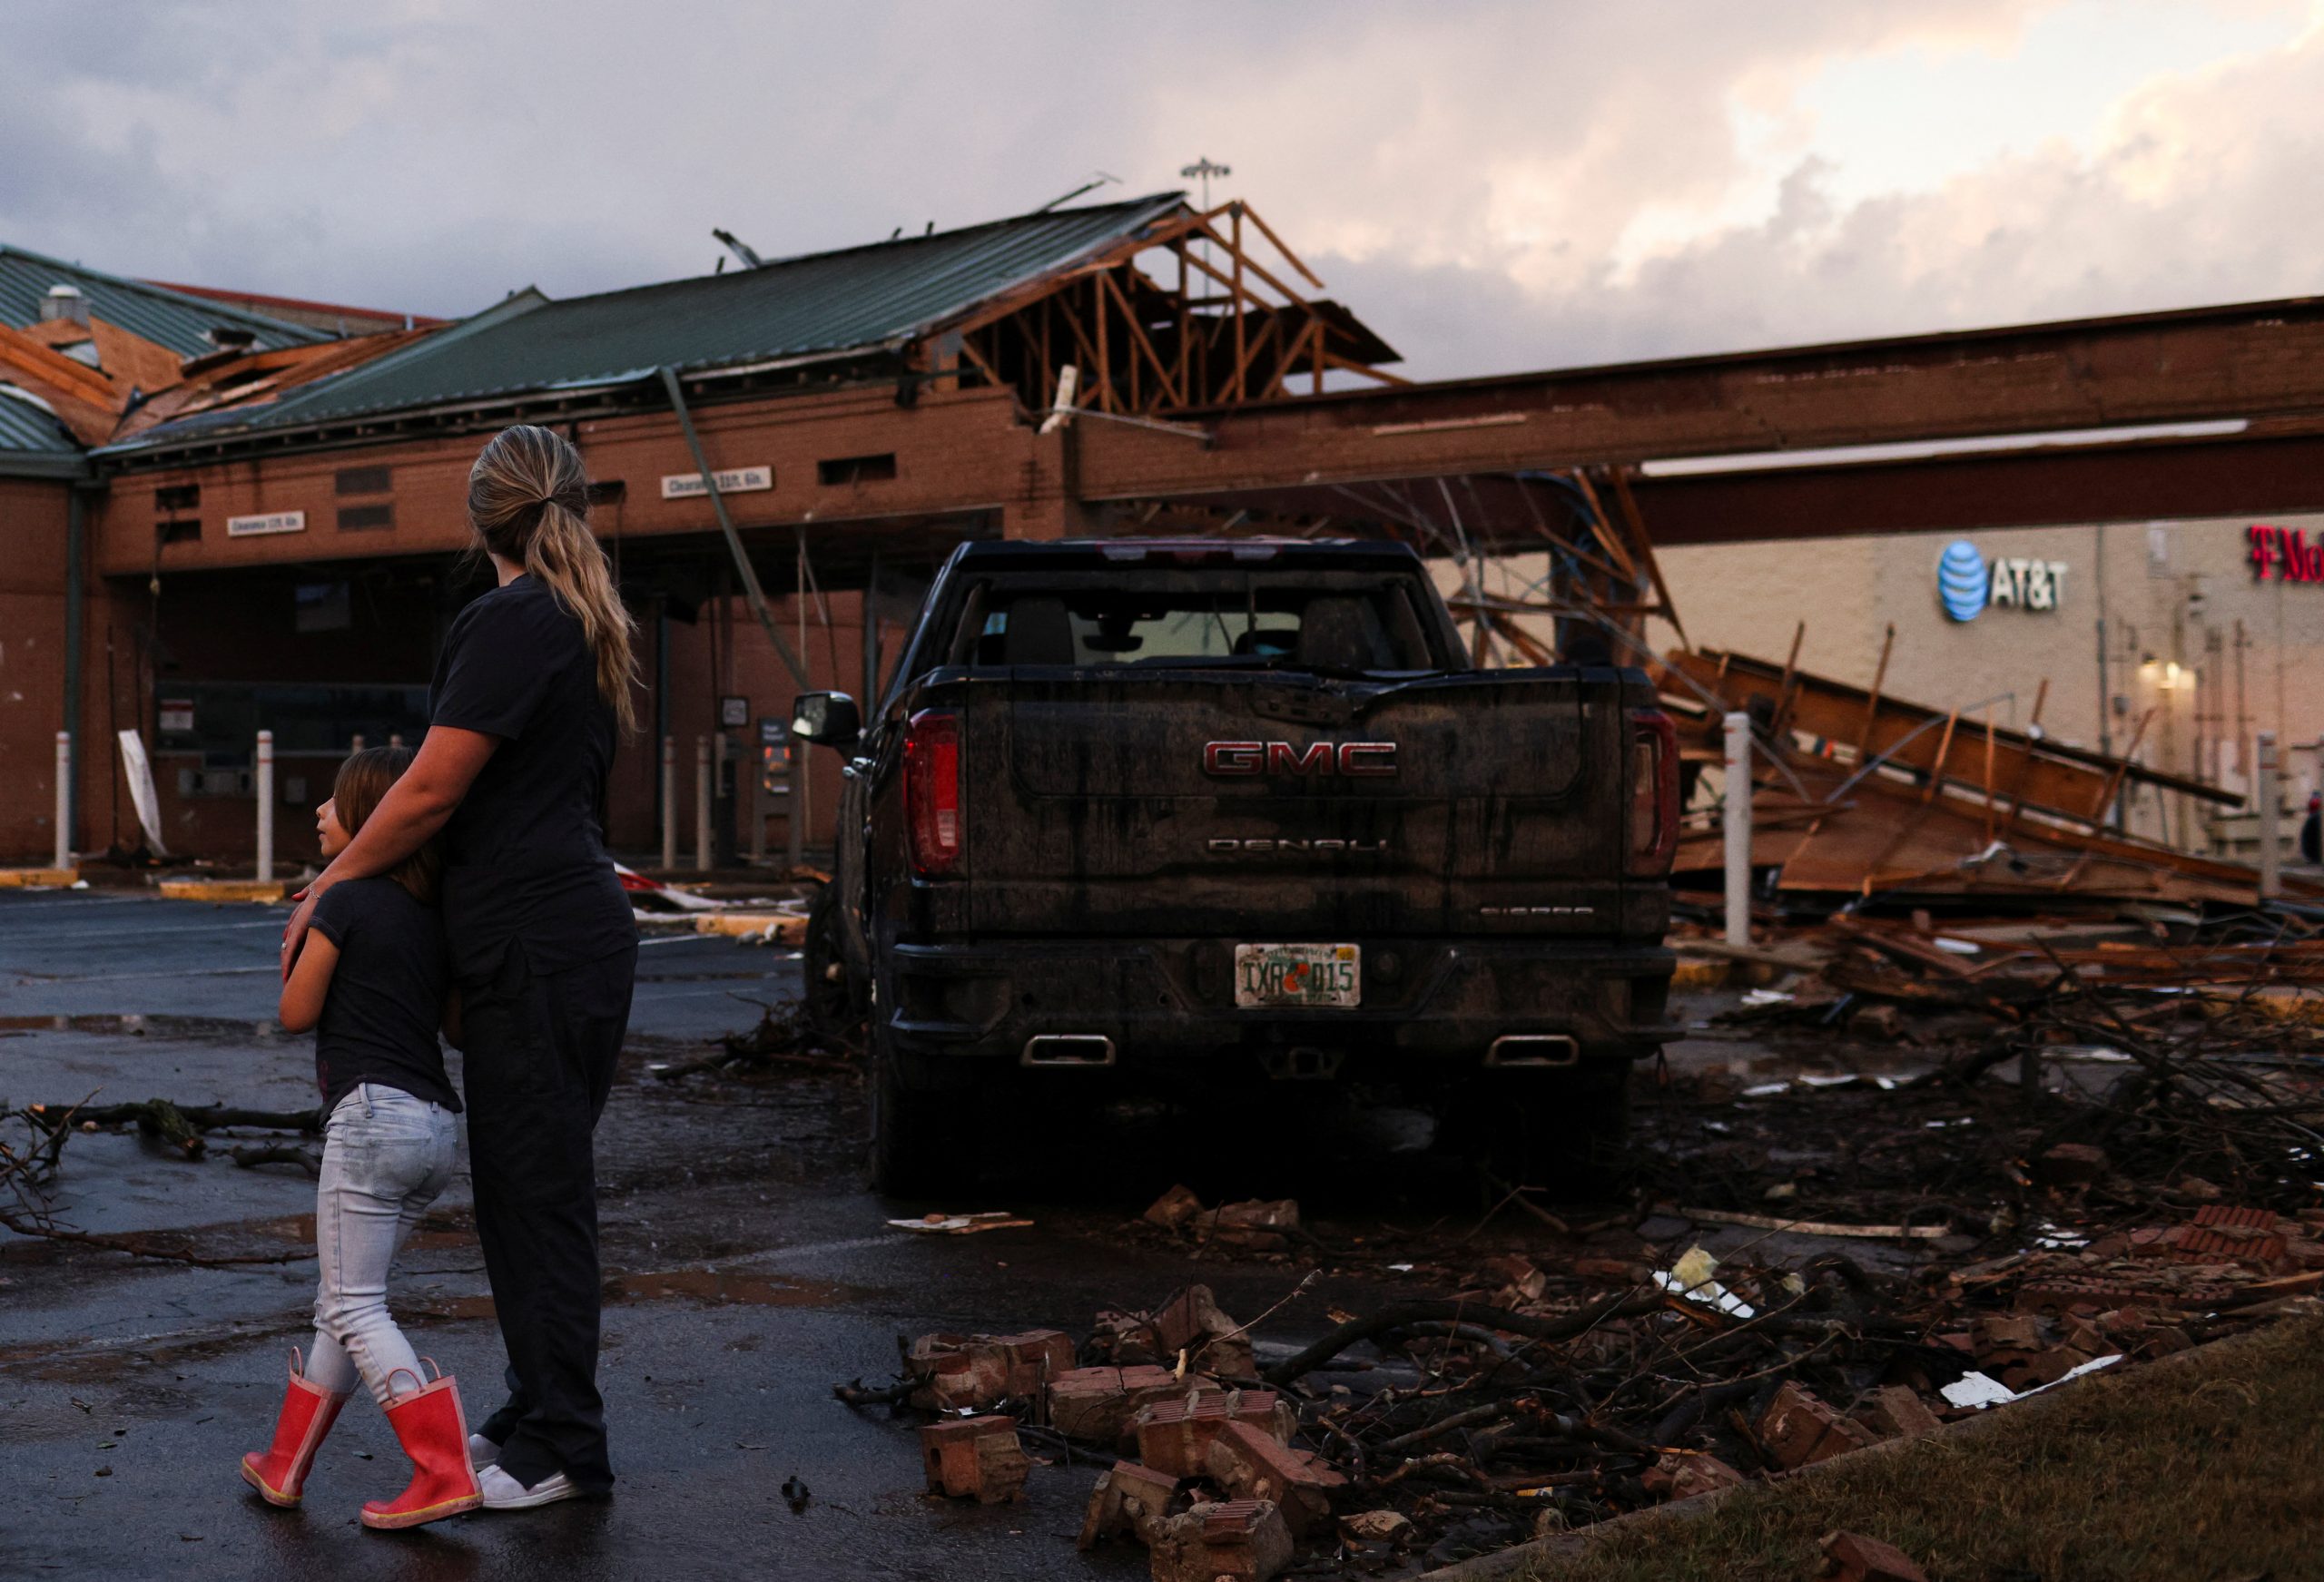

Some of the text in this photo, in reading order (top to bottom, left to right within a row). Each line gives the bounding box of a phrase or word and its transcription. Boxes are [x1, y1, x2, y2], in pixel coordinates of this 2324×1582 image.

[1990, 556, 2069, 610] AT&T
[1203, 741, 1397, 776] GMC
[1207, 839, 1387, 851] DENALI
